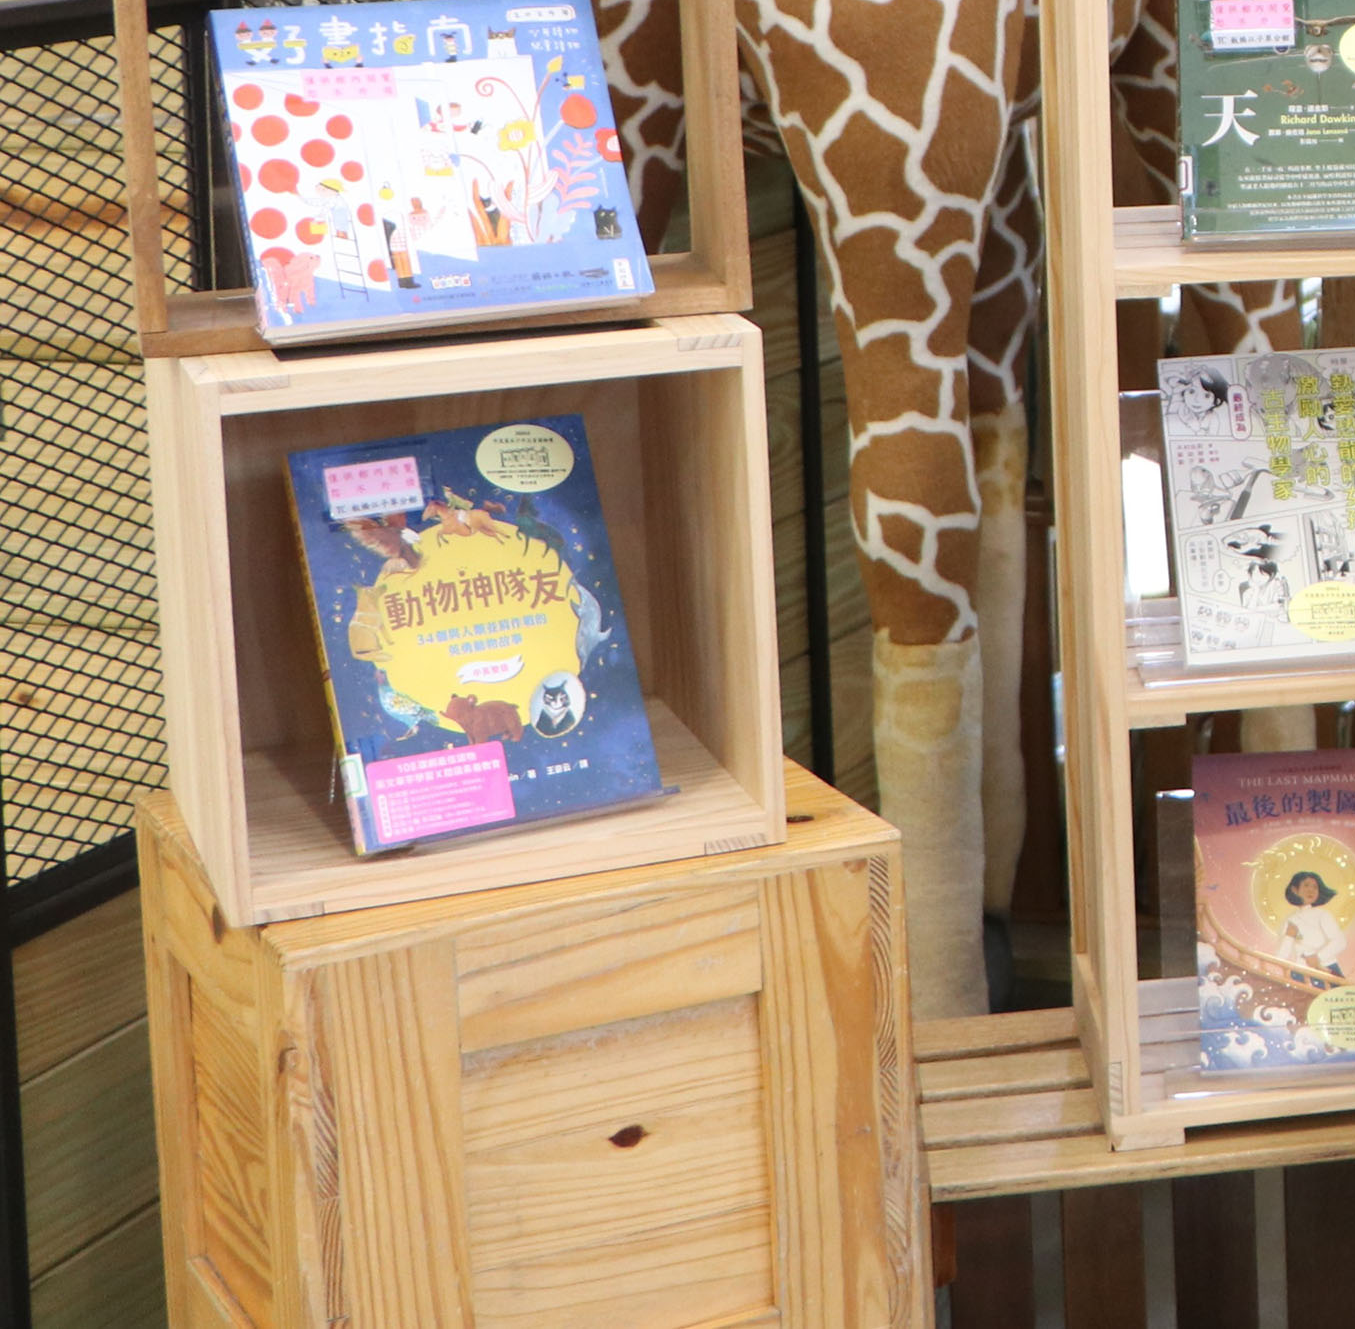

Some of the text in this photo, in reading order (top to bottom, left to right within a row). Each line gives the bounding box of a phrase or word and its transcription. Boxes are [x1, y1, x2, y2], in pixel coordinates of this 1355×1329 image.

[1201, 89, 1260, 147] 天
[1280, 115, 1317, 124] Richard
[385, 567, 566, 632] 動物神隊友
[1267, 775, 1298, 786] LAST
